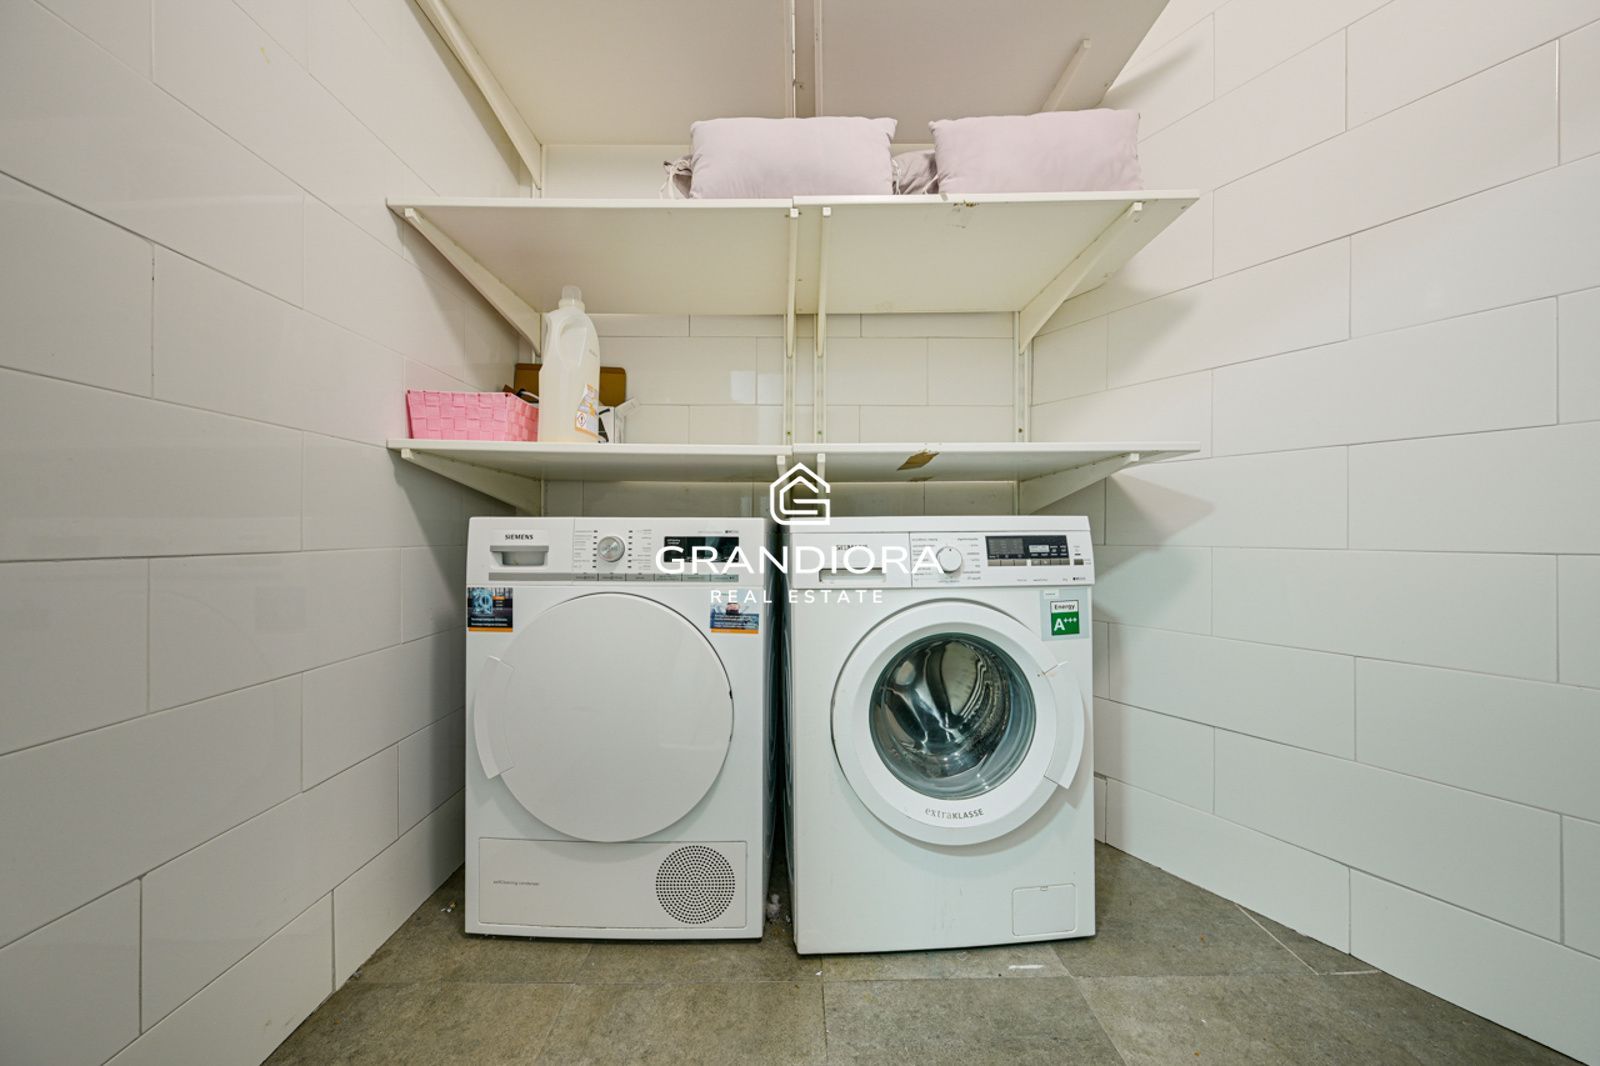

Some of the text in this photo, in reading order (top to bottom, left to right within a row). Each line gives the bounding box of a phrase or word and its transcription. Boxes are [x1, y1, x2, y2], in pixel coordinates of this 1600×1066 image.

[504, 533, 534, 541] SIEMENS
[1054, 603, 1076, 611] Energy
[1053, 616, 1078, 632] A+++
[925, 808, 984, 819] extraKLASSE
